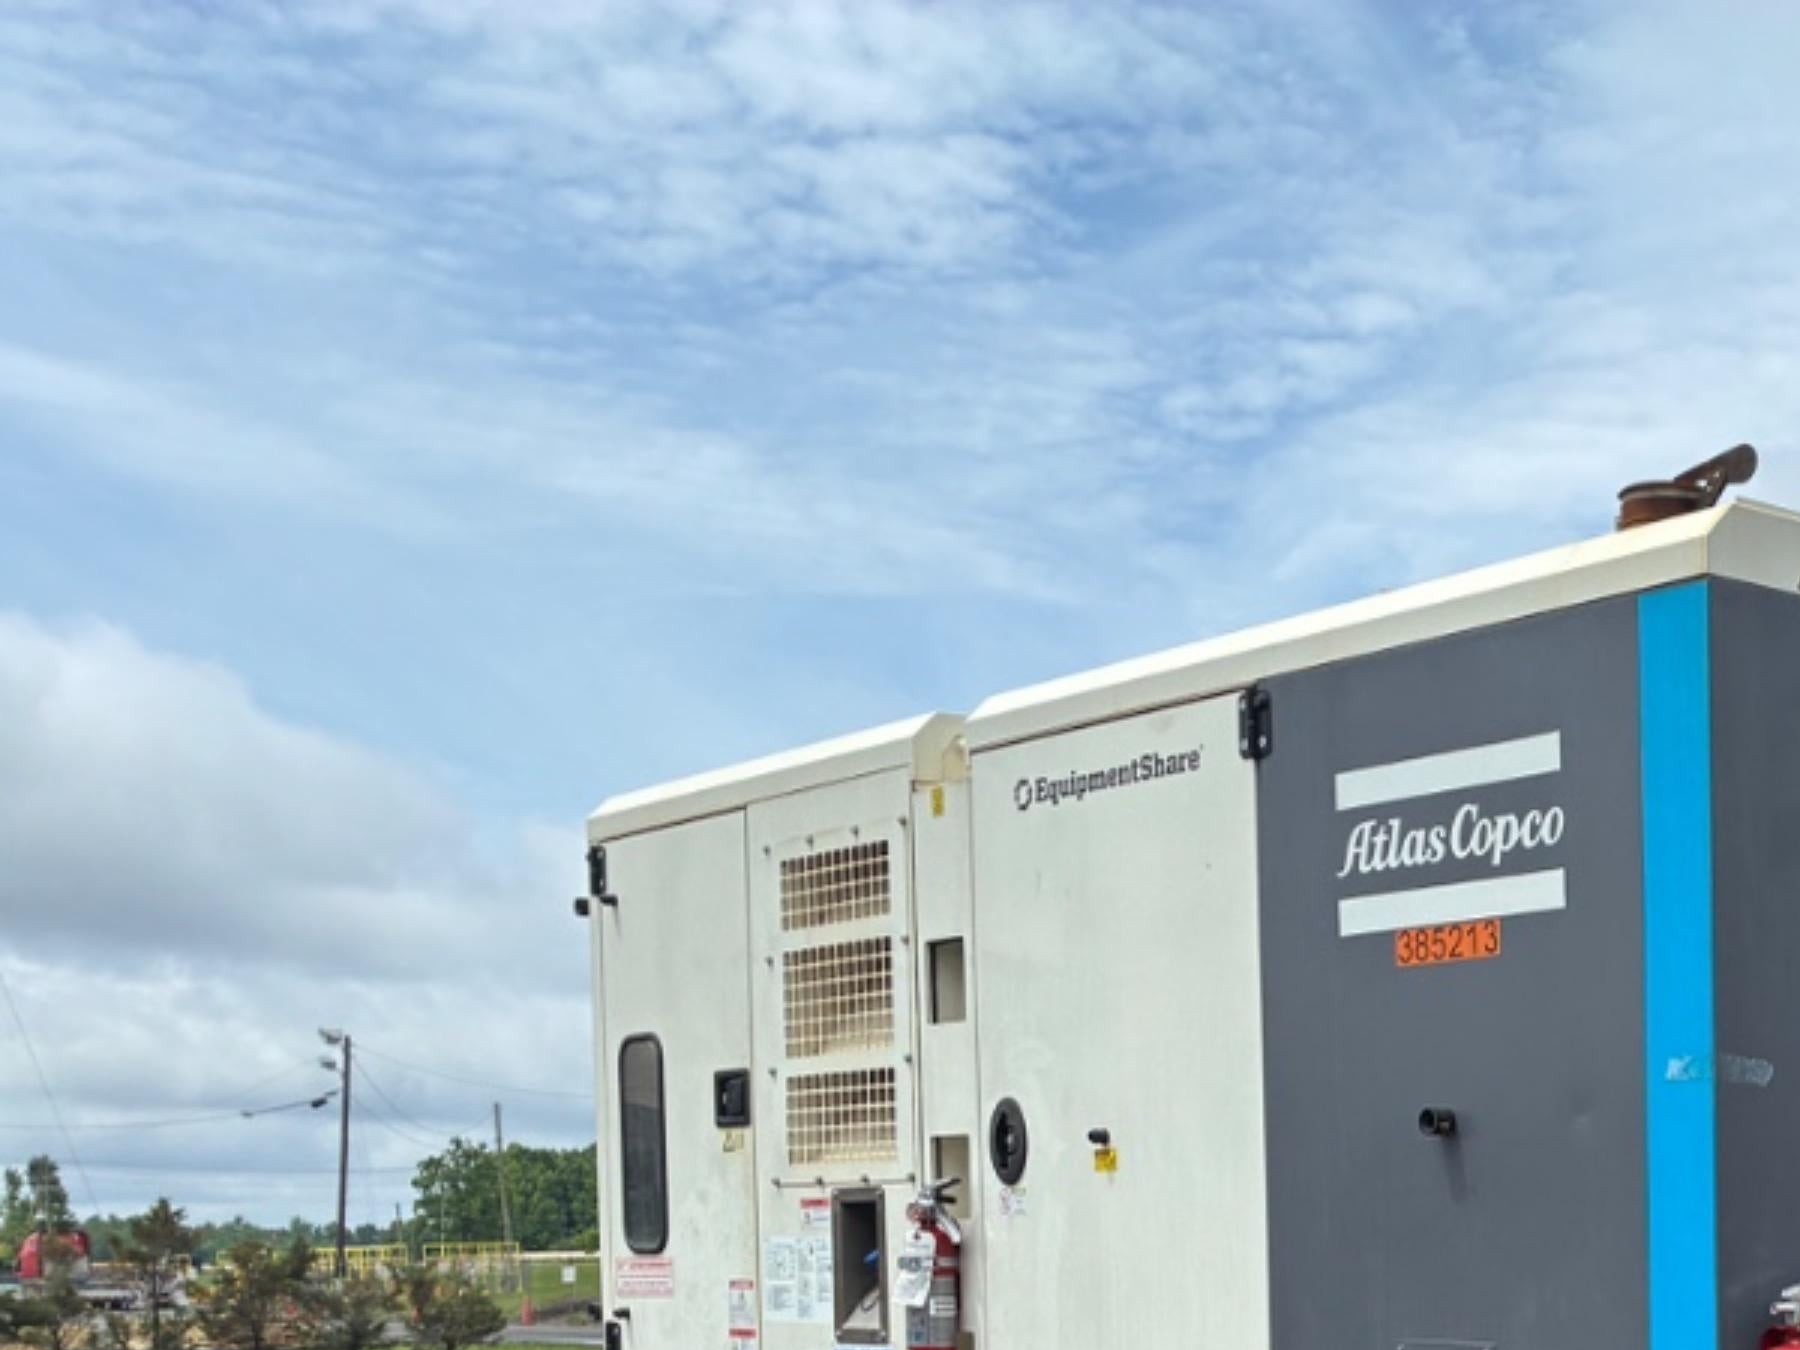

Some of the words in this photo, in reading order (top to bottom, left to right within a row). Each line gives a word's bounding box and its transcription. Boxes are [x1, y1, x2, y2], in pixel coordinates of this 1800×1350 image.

[1034, 748, 1203, 806] EquipmentShare
[1336, 813, 1447, 878] Atlas
[1449, 803, 1565, 867] Copco
[1398, 920, 1499, 964] 385213
